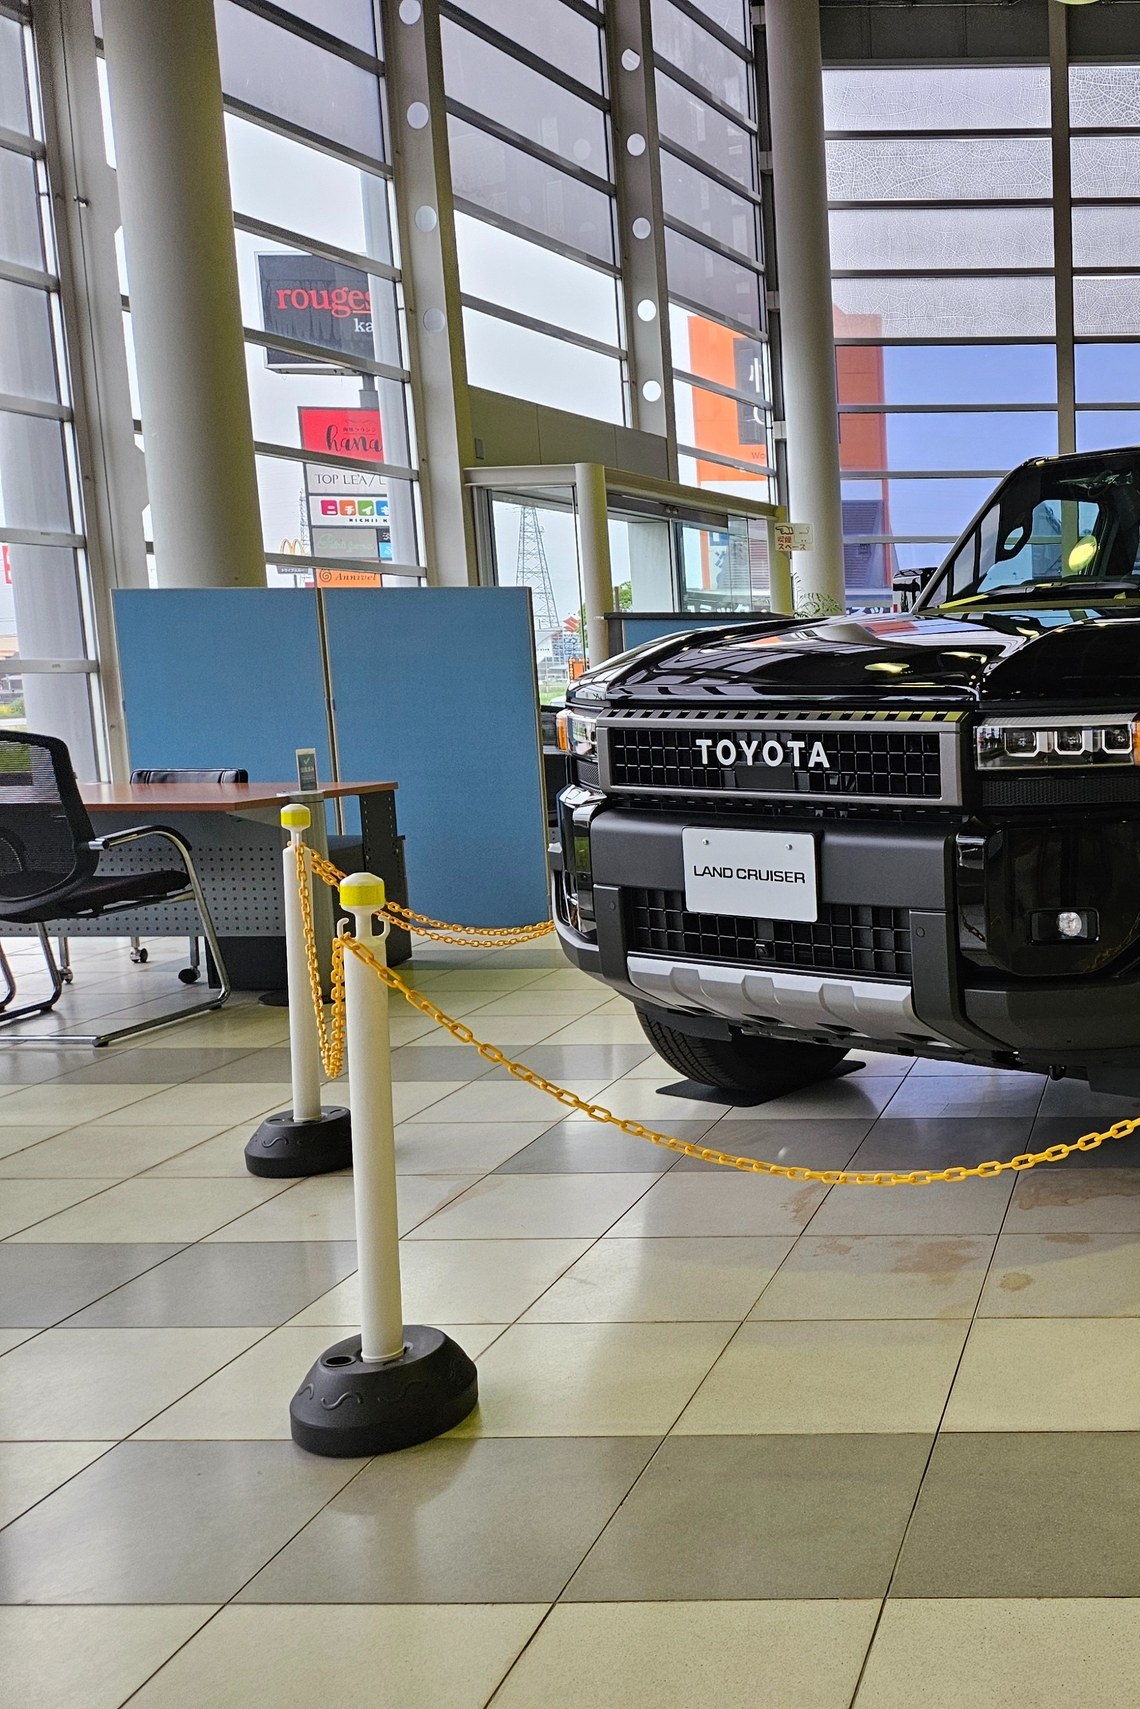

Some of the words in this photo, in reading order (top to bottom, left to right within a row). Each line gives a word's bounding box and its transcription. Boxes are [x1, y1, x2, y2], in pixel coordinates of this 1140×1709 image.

[314, 473, 339, 485] TOP
[778, 543, 806, 551] スペース
[695, 738, 830, 768] TOYOTA
[693, 865, 734, 879] LAND
[736, 867, 806, 884] CRUISER
